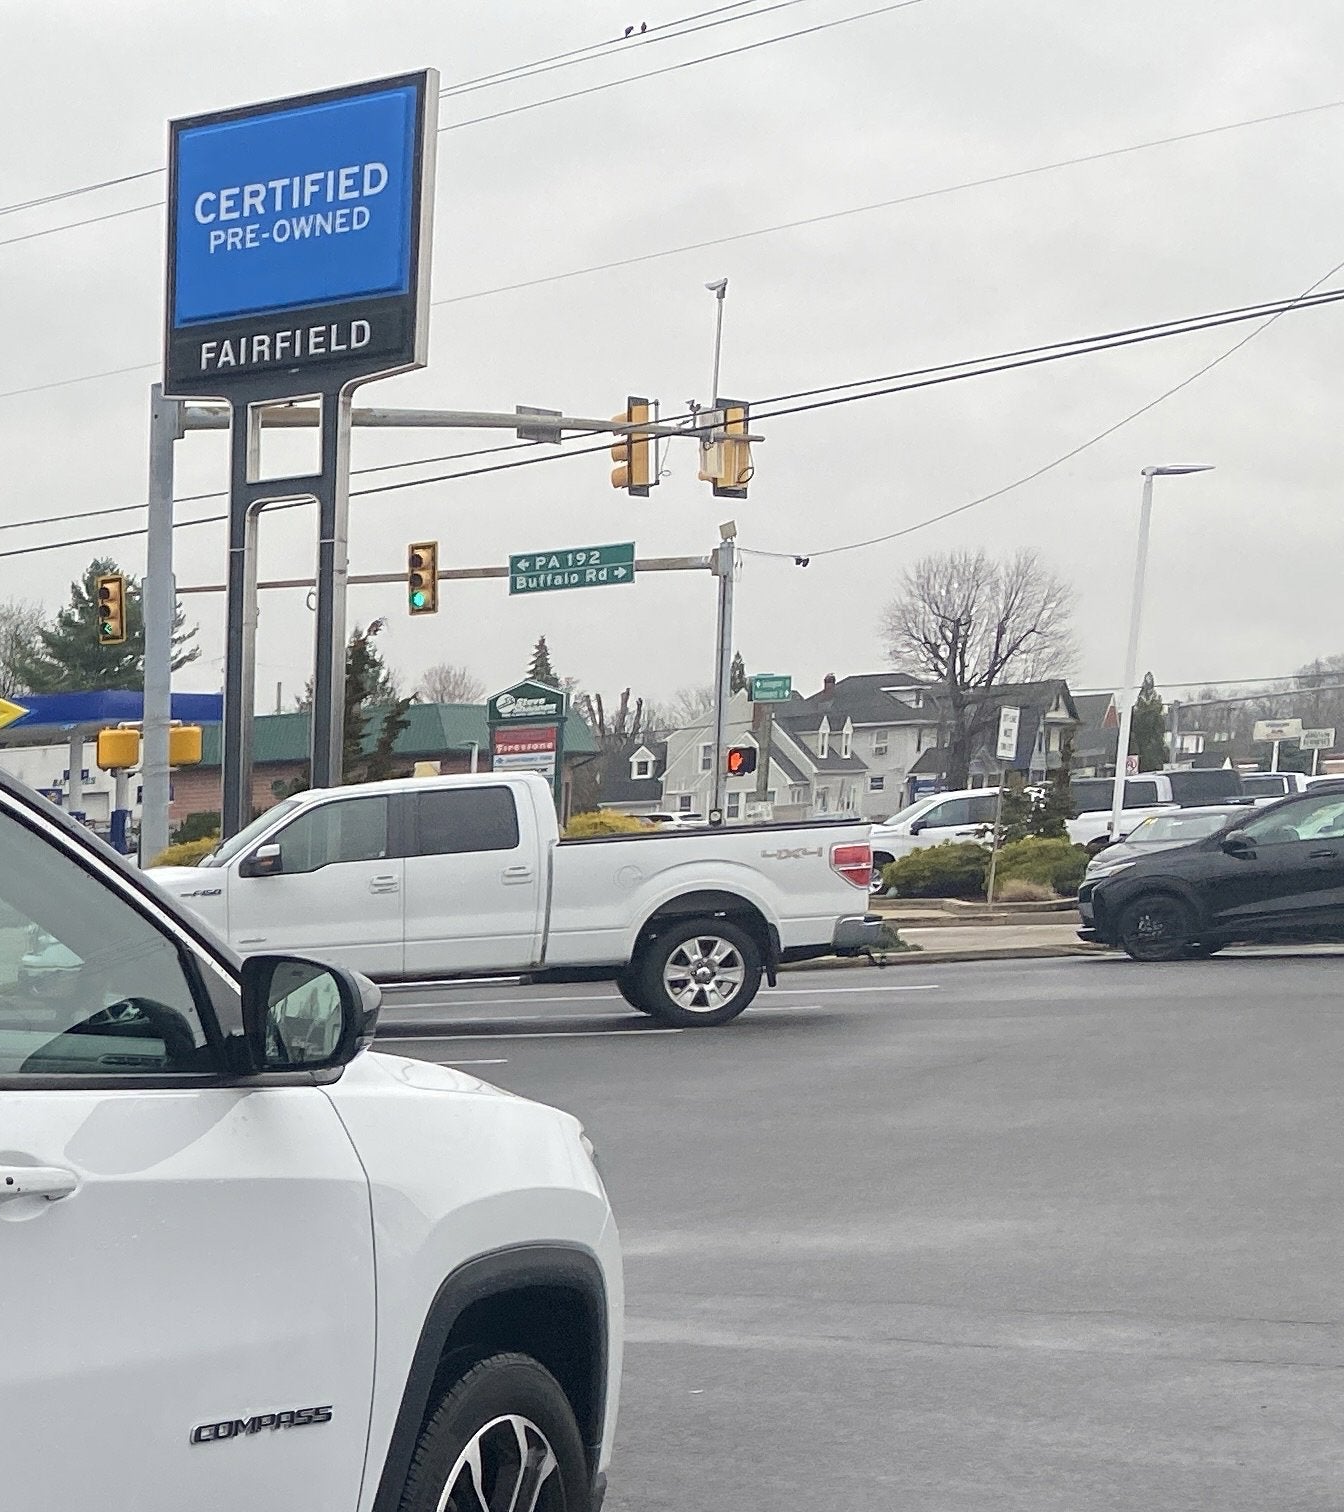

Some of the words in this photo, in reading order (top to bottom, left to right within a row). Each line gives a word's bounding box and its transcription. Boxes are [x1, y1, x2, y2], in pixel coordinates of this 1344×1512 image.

[194, 162, 389, 224] CERTIFIED
[209, 206, 371, 254] PRE-OWNED
[200, 319, 372, 371] FAIRFIELD
[516, 572, 579, 589] Buffalo
[585, 568, 608, 582] Rd
[535, 555, 560, 570] PA
[567, 550, 601, 567] 192
[190, 1405, 333, 1445] COMPASS
